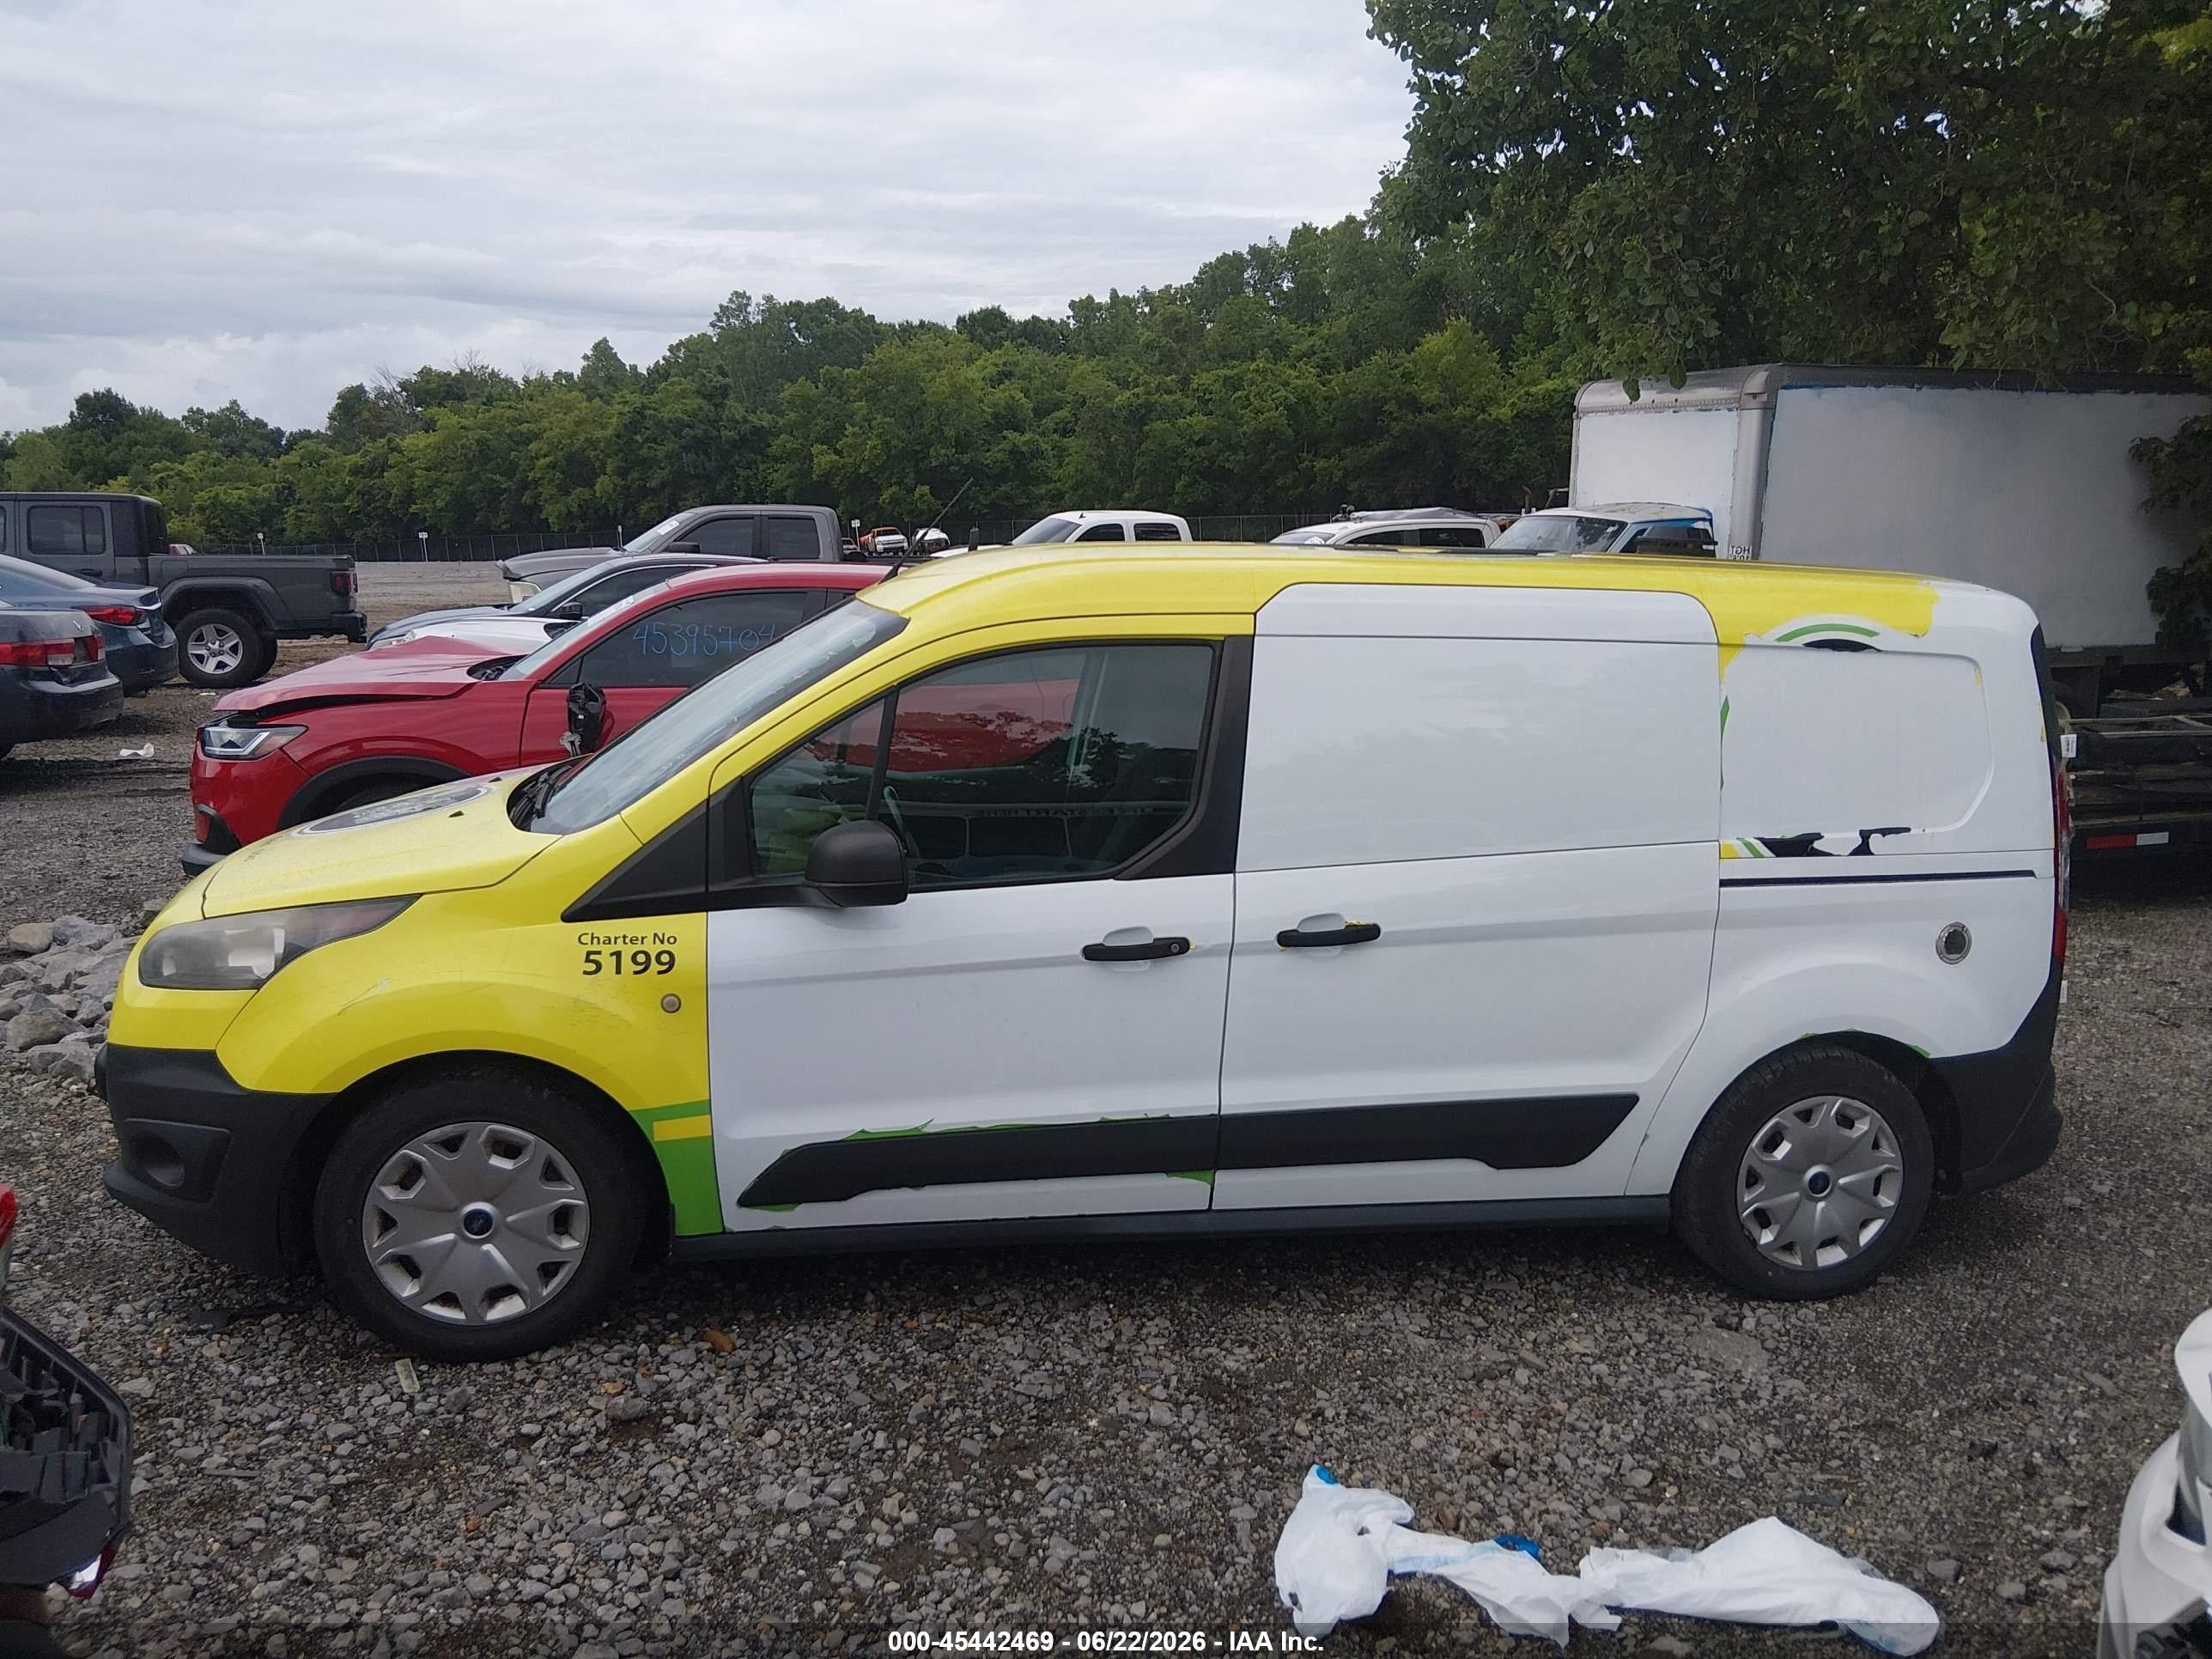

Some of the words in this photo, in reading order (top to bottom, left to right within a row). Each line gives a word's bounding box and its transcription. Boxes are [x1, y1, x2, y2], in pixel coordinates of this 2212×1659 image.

[633, 623, 776, 656] 45395704
[578, 933, 647, 945] Charter
[653, 933, 678, 945] No
[582, 950, 676, 975] 5199
